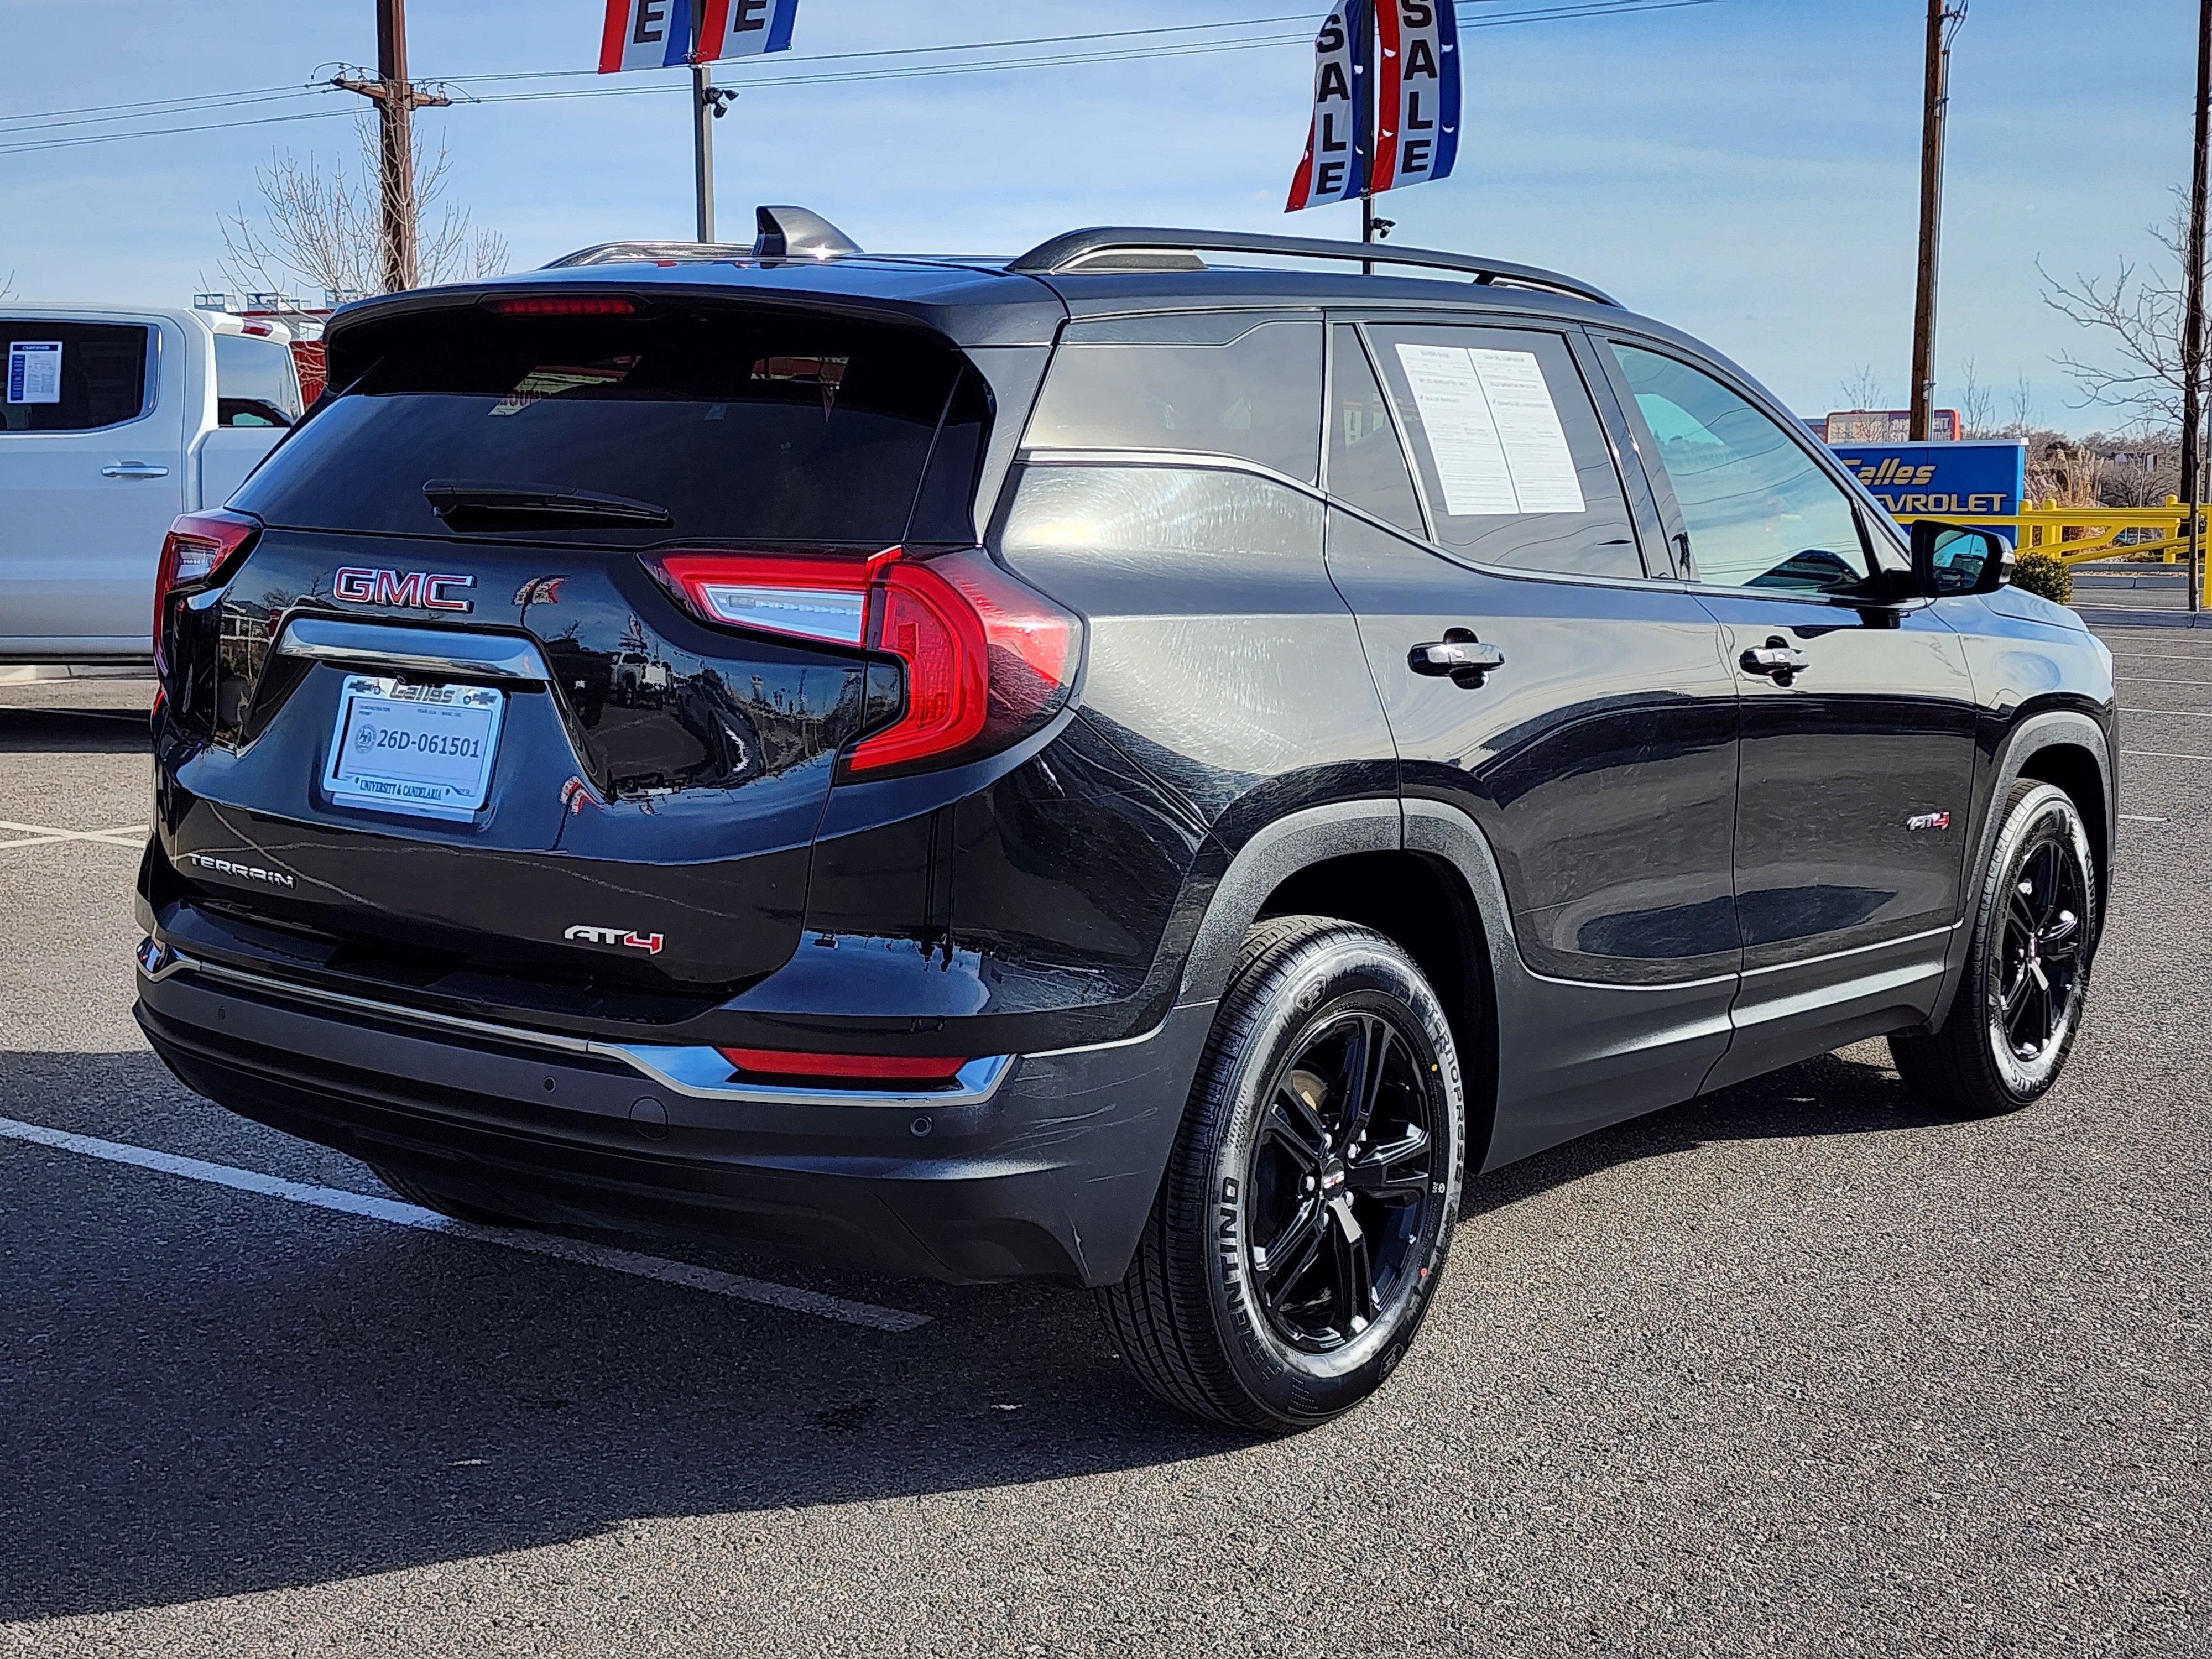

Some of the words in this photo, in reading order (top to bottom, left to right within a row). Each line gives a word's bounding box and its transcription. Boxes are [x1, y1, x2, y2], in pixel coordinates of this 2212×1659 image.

[1400, 0, 1438, 174] SALE
[1315, 13, 1350, 196] SALE
[333, 566, 476, 612] GMC
[377, 729, 480, 758] 26D-061501
[359, 779, 397, 795] UNIVERSITY
[403, 785, 442, 801] CANDELARIA
[1906, 812, 1950, 831] AT4
[186, 852, 295, 889] TERRAIN
[564, 925, 665, 956] AT4
